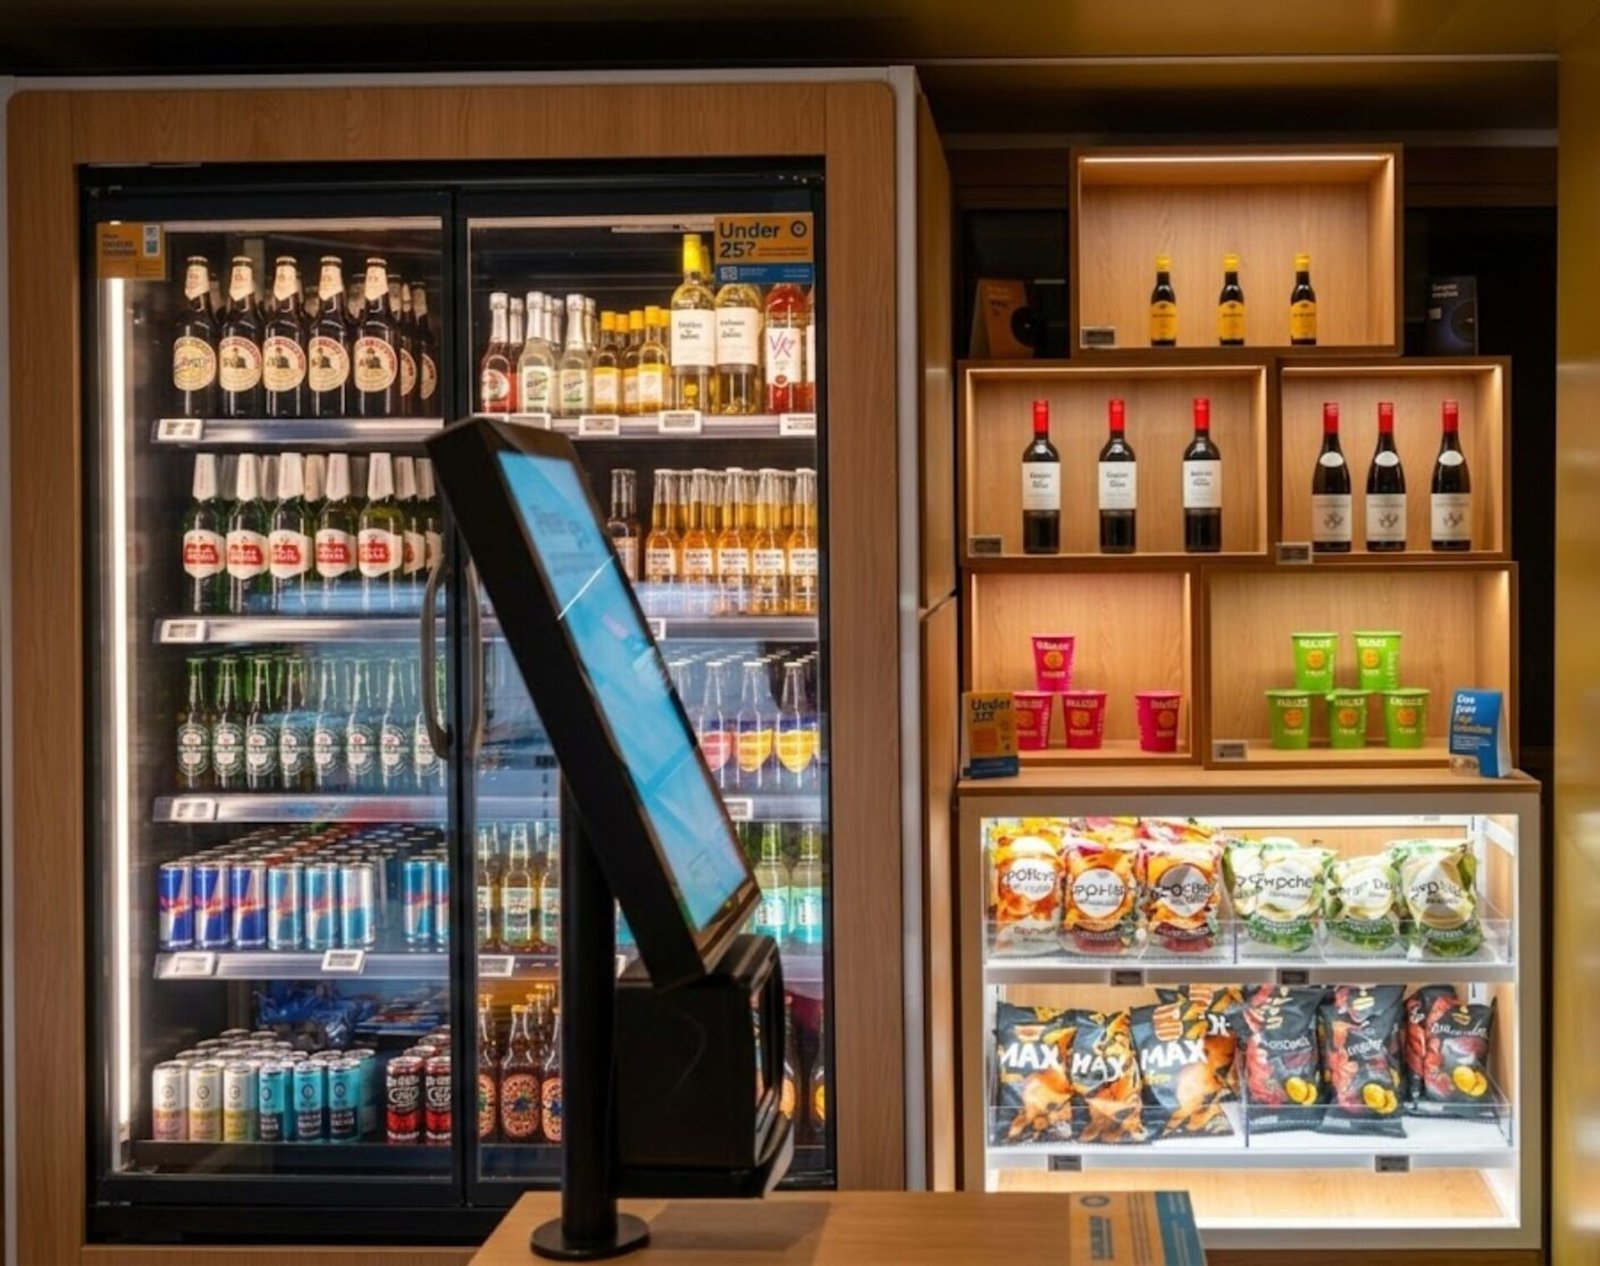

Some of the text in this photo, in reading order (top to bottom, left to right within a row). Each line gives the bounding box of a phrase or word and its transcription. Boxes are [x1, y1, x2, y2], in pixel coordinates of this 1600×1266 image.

[719, 221, 780, 239] Under
[720, 242, 756, 258] 25?
[1000, 1043, 1062, 1069] MAX
[1142, 1039, 1208, 1070] MAX
